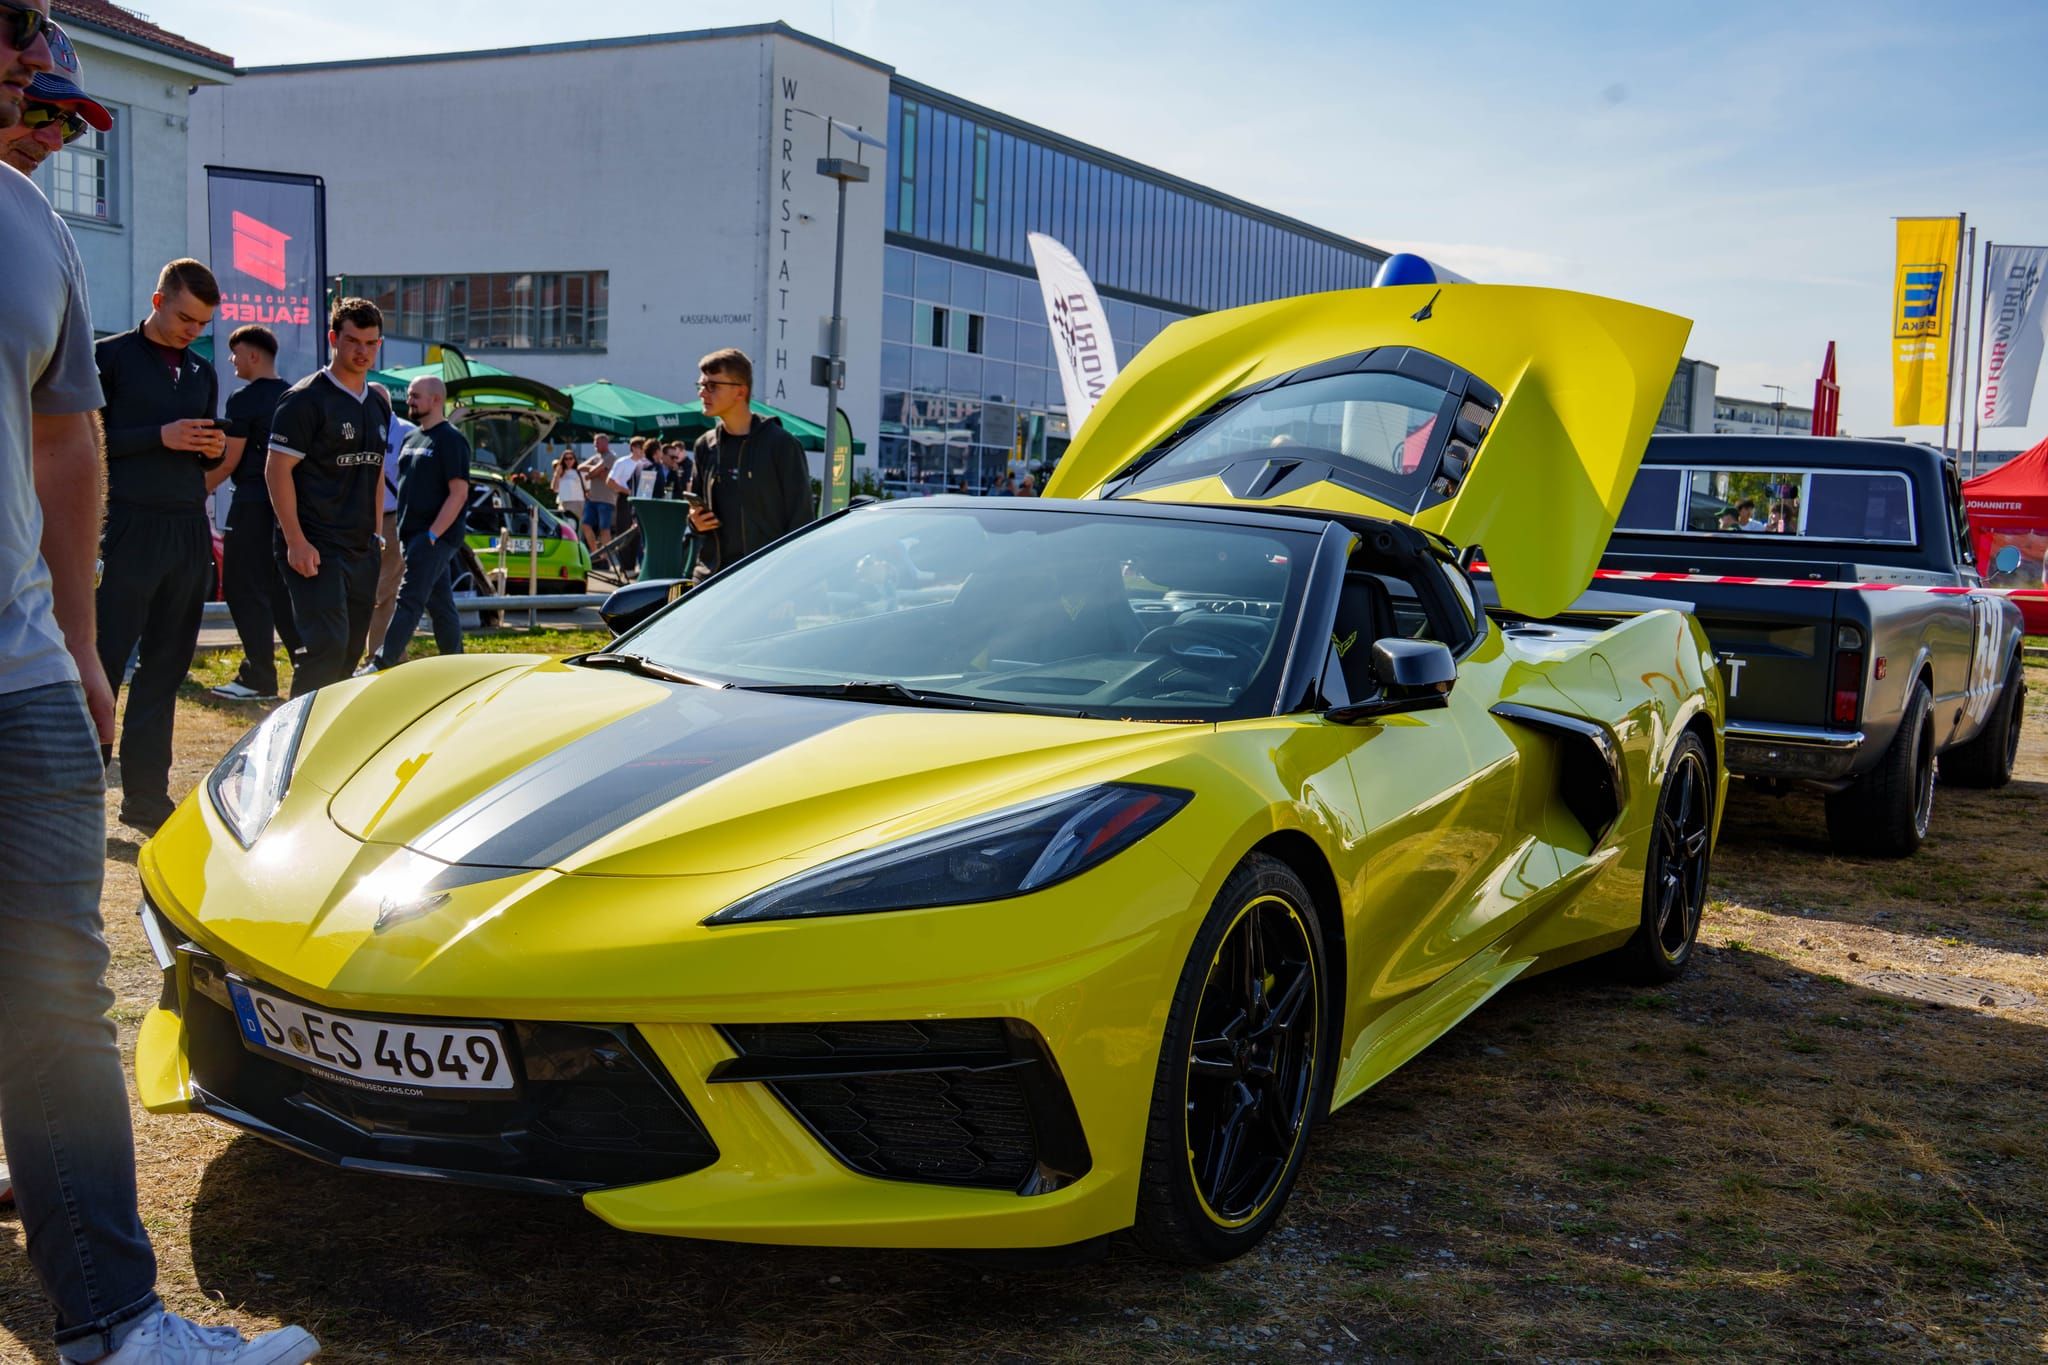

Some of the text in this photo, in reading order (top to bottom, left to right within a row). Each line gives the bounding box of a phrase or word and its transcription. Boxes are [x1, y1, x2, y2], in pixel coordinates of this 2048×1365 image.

[774, 76, 798, 400] WERKSTATTHA
[680, 314, 752, 325] KASSENAUTOMAT
[1984, 265, 2027, 420] MOTORWORLD
[1966, 500, 2022, 511] JOHANNITER
[246, 1018, 257, 1032] D
[256, 996, 499, 1082] S ES 4649
[311, 1066, 424, 1097] WWW.RAMSTEINUSEDCARS.COM
